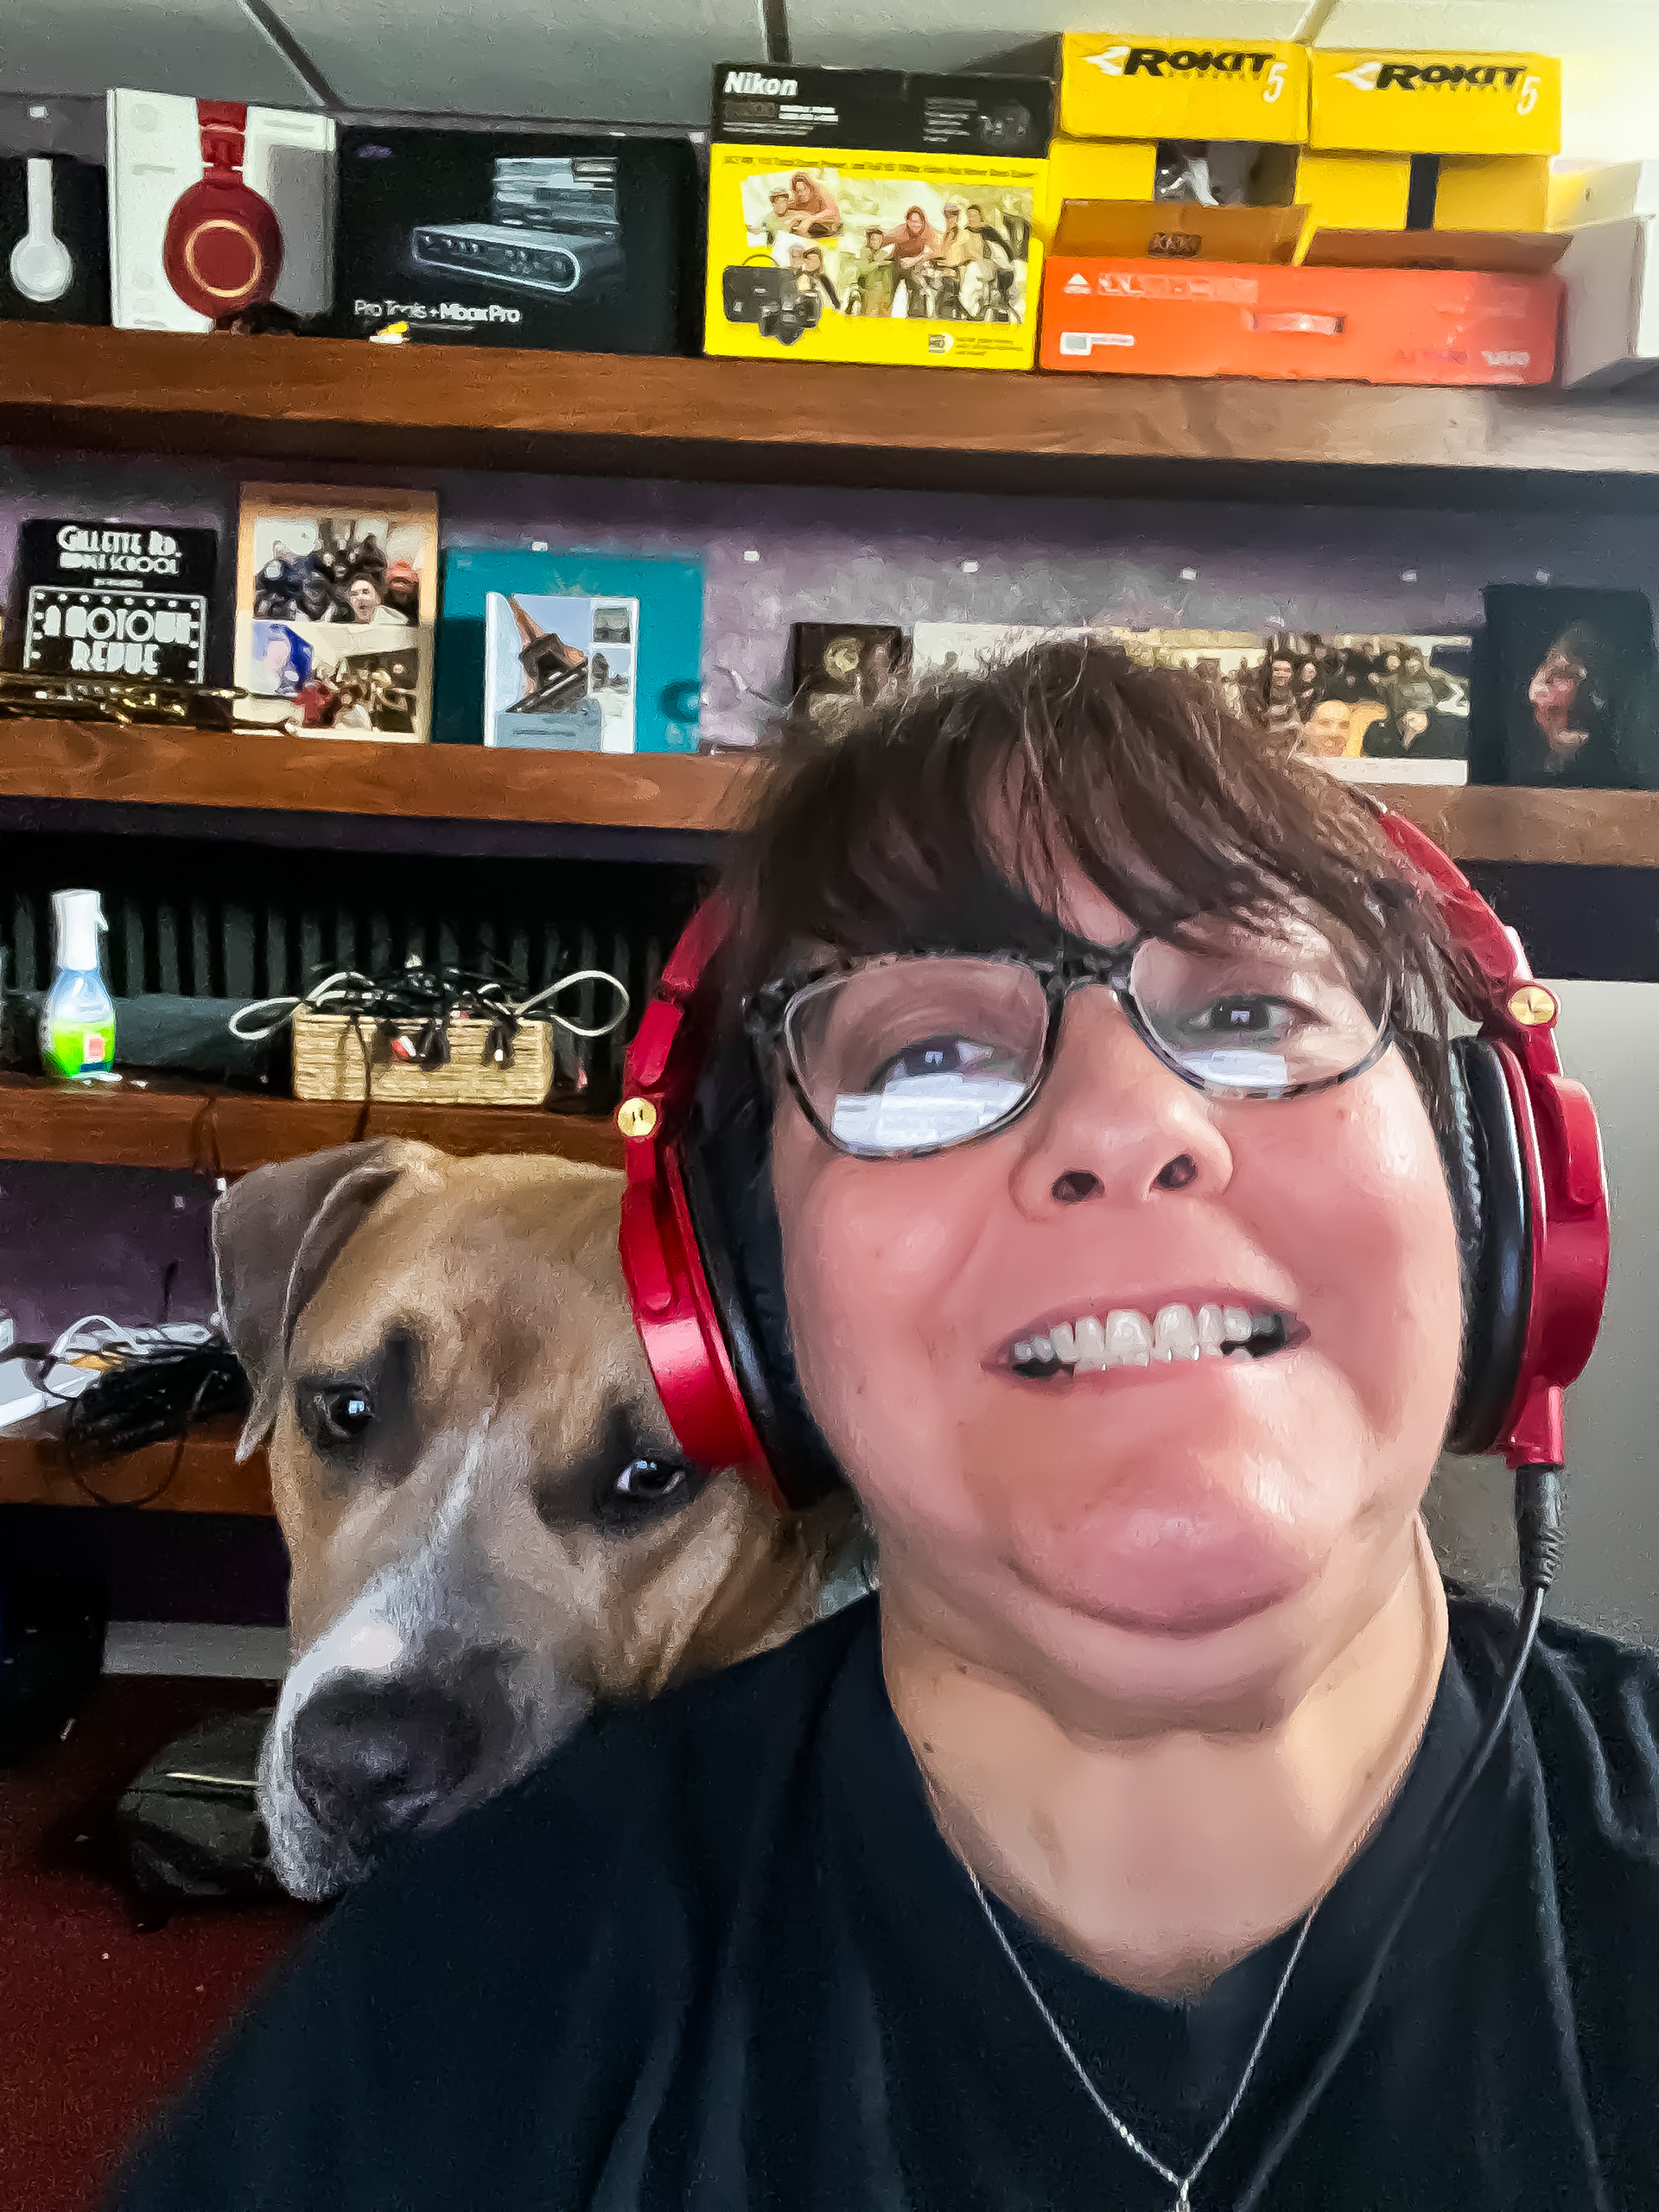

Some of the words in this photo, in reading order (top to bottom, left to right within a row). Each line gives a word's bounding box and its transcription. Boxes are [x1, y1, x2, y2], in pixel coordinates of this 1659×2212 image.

[723, 71, 798, 96] Nikon
[1122, 48, 1276, 77] ROKIT
[1263, 61, 1289, 104] 5
[1376, 63, 1529, 92] ROKIT
[1517, 74, 1541, 116] 5
[353, 299, 383, 317] Pro
[489, 304, 521, 323] Pro
